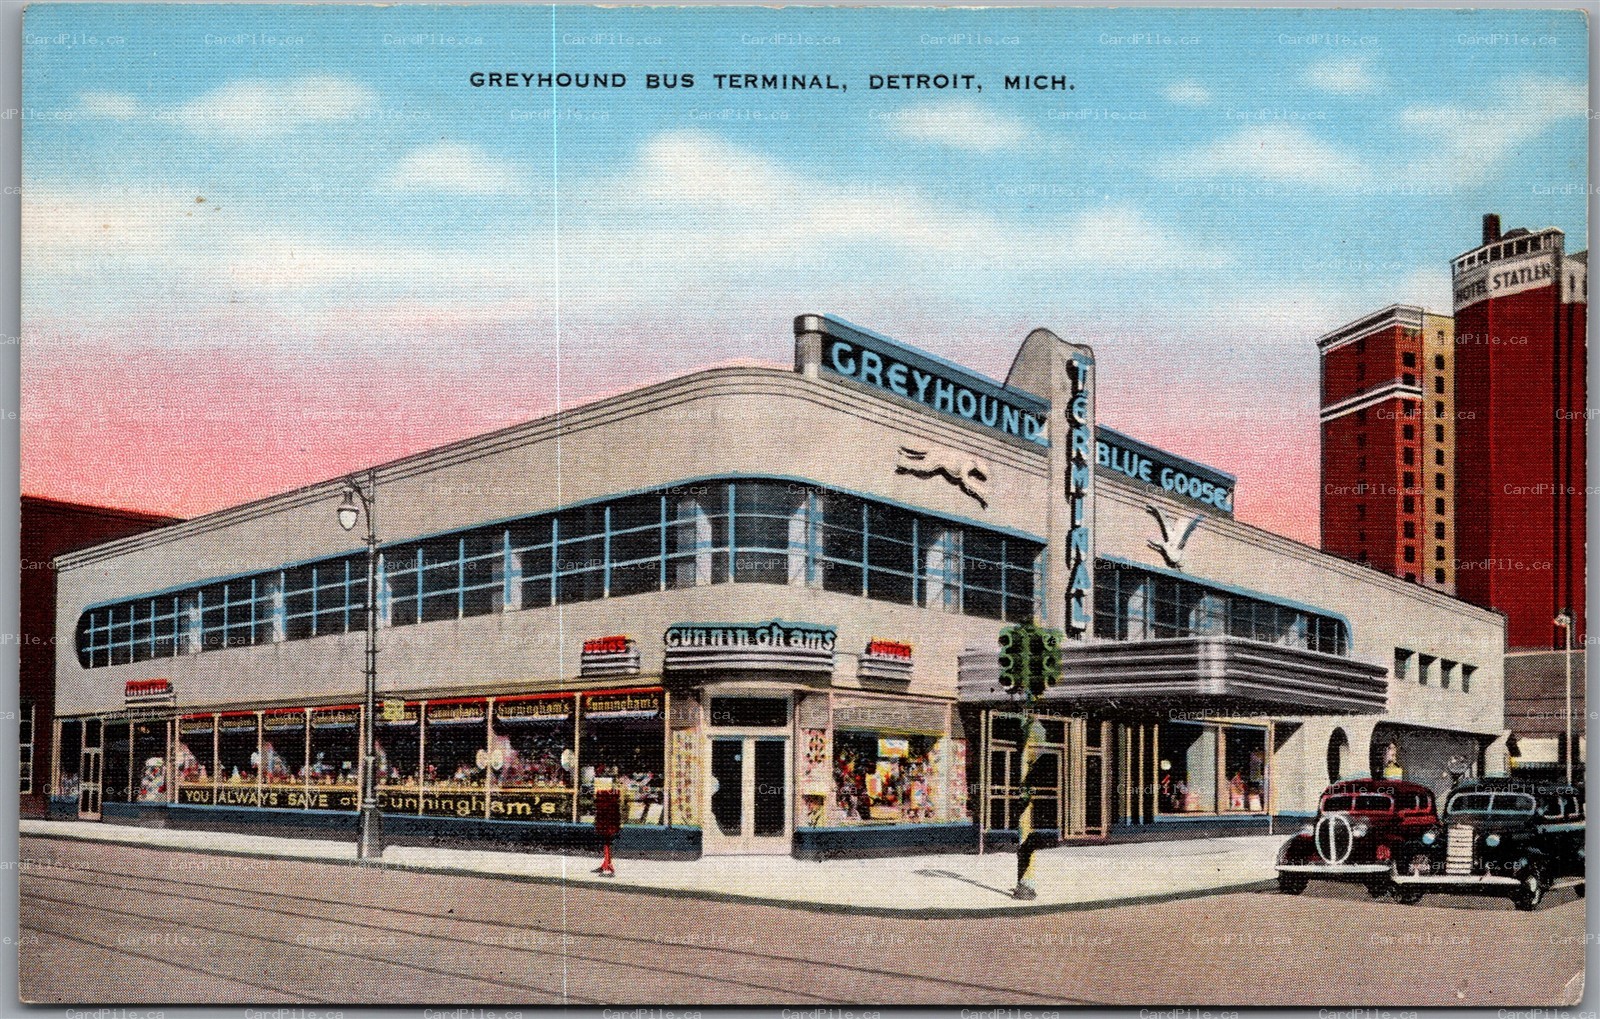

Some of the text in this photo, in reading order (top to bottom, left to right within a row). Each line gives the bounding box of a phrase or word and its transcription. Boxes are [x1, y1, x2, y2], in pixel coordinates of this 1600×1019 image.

[470, 73, 1075, 92] GREYHOUND BUS TERMINAL, DETROIT, MICH.
[831, 341, 1041, 442] GREYHOUND
[1069, 351, 1094, 628] TERMINAL
[1095, 441, 1232, 512] BLUE GOOSE
[185, 790, 209, 803] YOU
[218, 790, 278, 806] ALWAYS
[287, 794, 328, 808] SAVE
